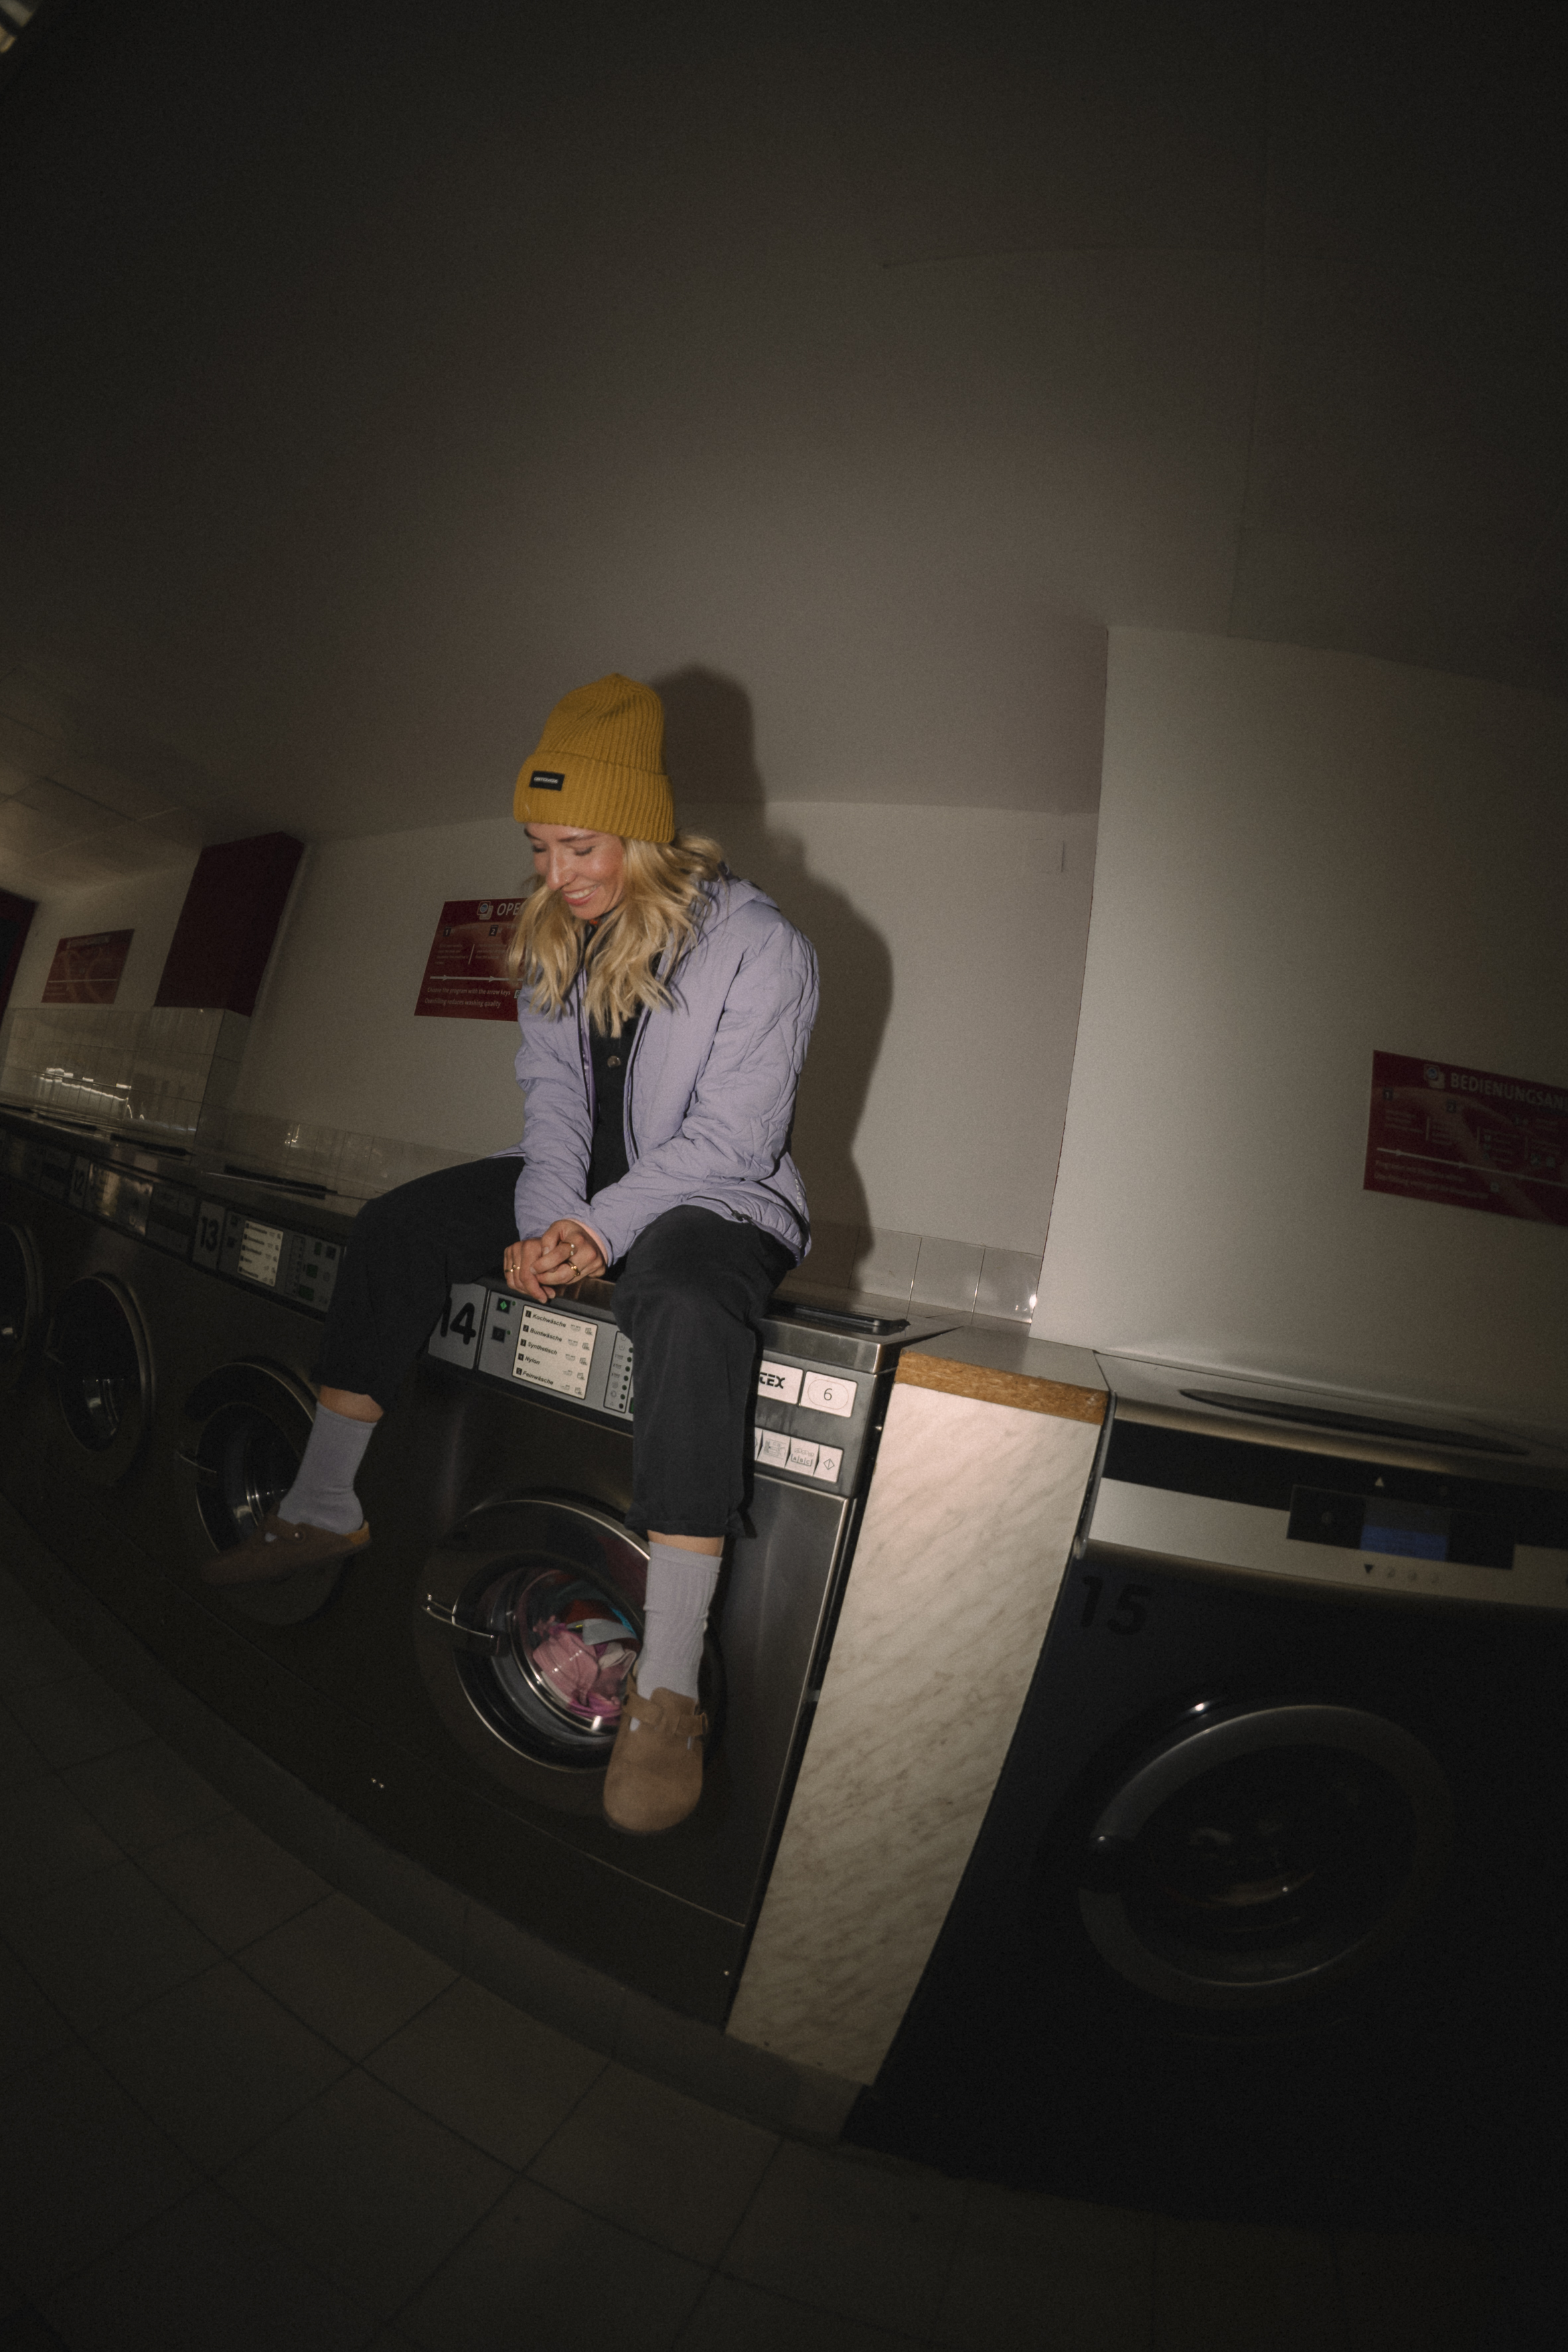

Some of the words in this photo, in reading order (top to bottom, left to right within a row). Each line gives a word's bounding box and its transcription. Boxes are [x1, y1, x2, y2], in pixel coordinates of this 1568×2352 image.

[424, 998, 447, 1006] Overfilling
[465, 999, 483, 1008] washing
[484, 1000, 501, 1008] quality
[200, 1216, 218, 1251] 13
[532, 1313, 566, 1328] Kochwäsche
[530, 1328, 562, 1342] Buntwäsche
[527, 1341, 558, 1355] Synthetisch
[524, 1356, 540, 1365] Nylon
[522, 1370, 554, 1385] Feinwäsche
[823, 1388, 832, 1401] 6
[1081, 1575, 1154, 1635] 15
